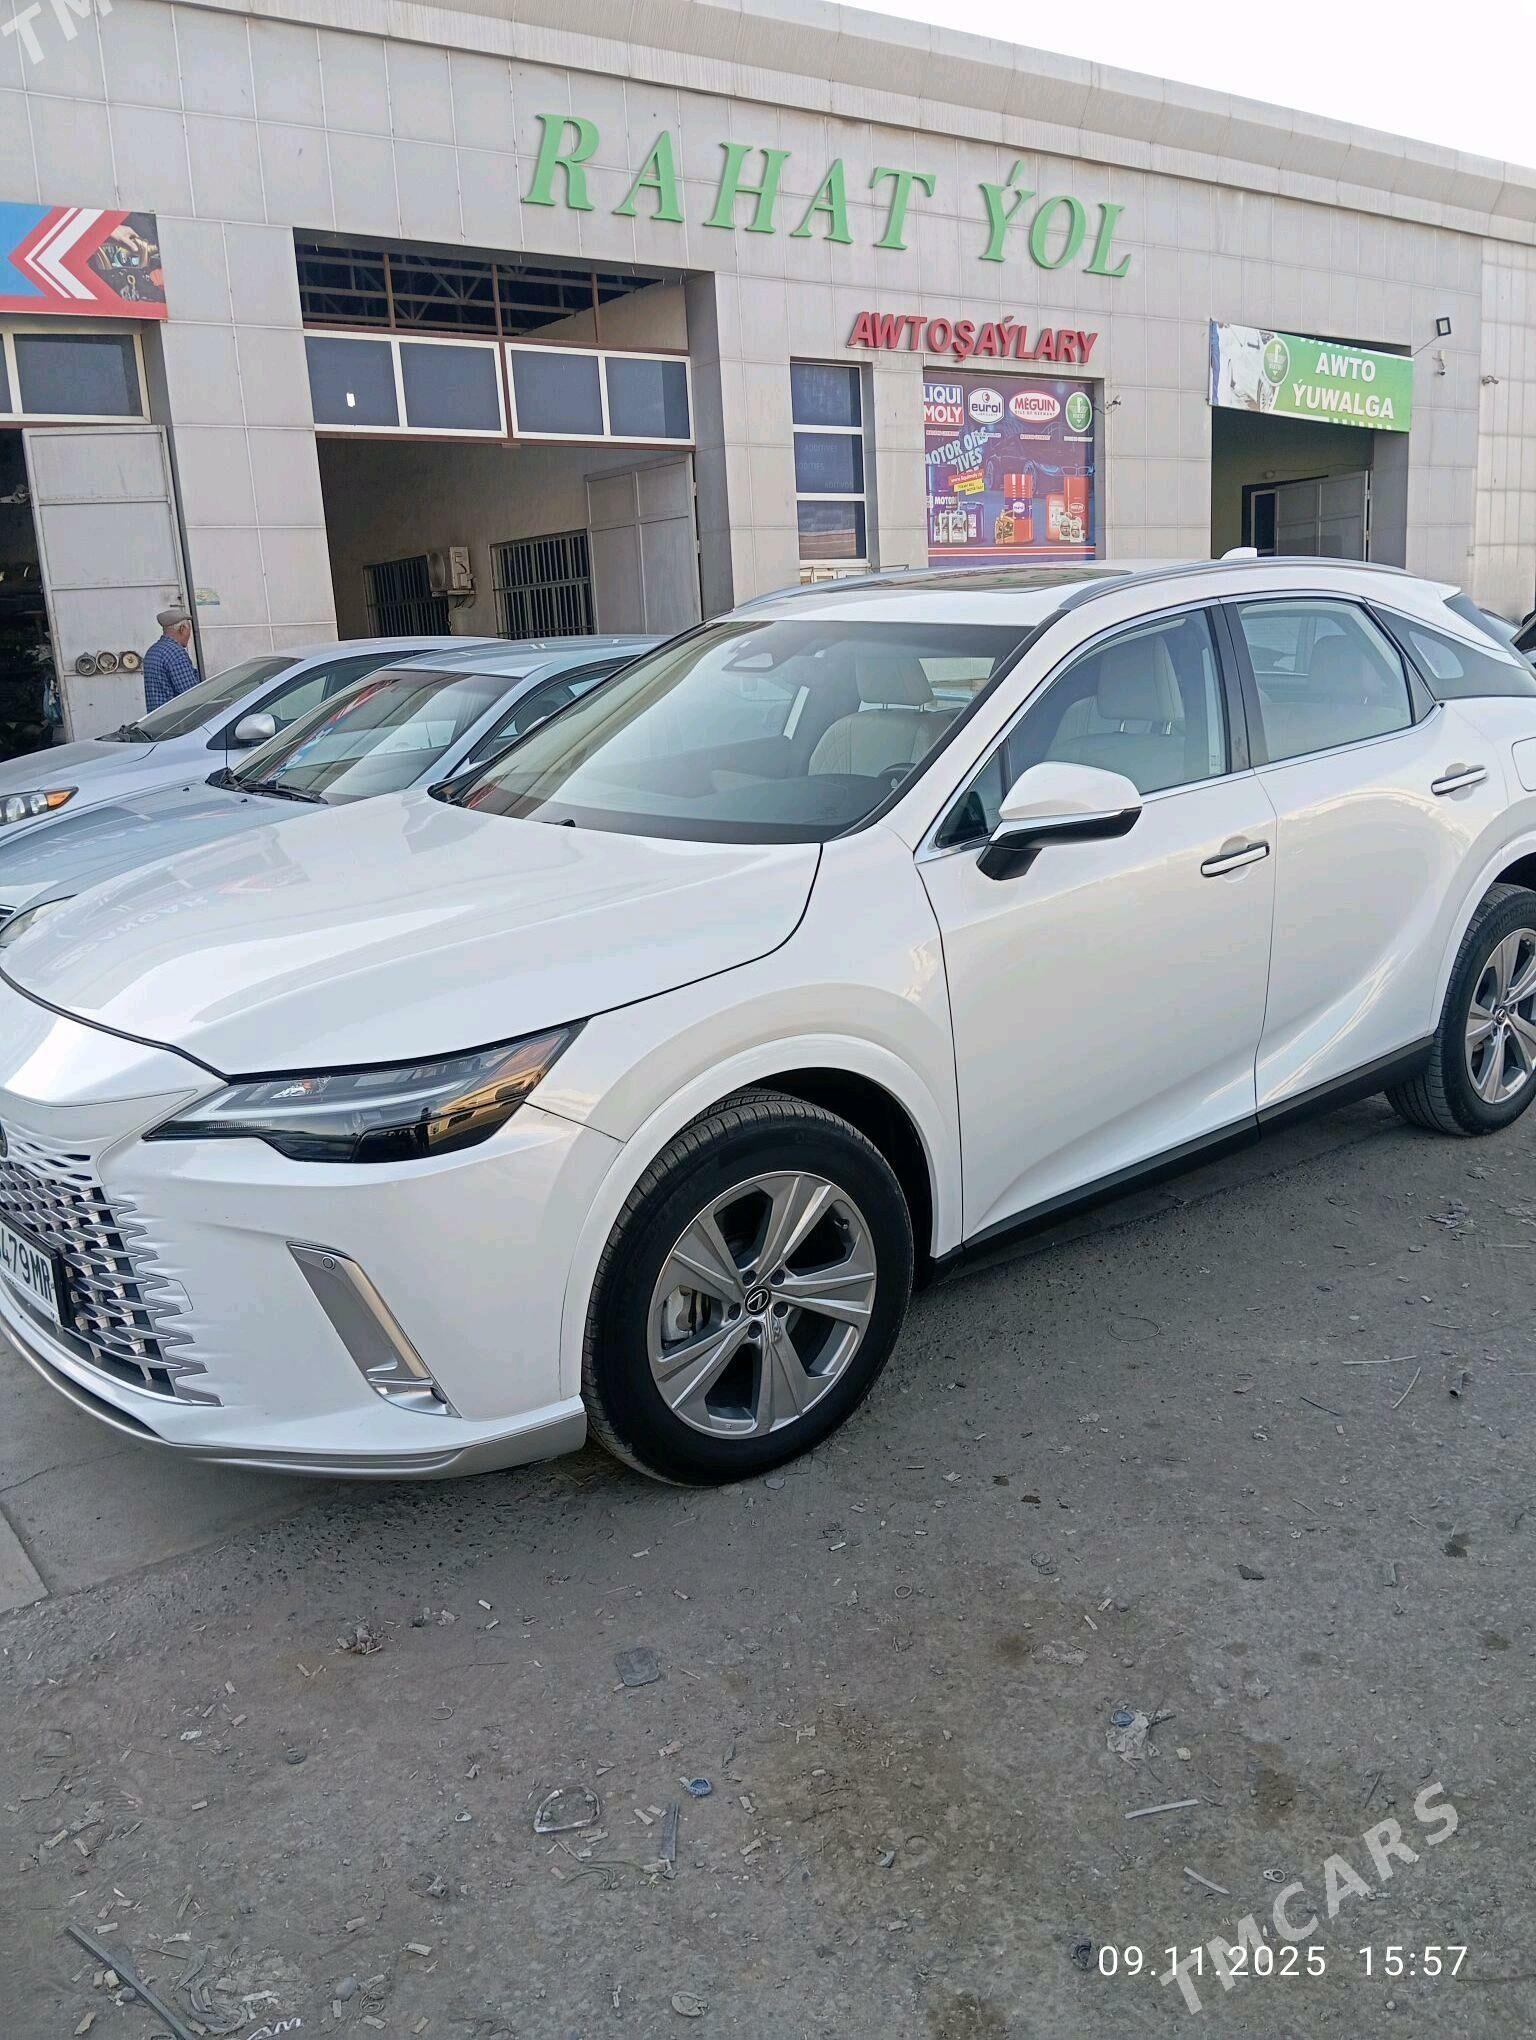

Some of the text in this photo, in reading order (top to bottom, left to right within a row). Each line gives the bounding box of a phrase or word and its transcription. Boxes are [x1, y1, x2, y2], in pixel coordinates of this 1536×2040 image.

[520, 113, 1132, 278] RAHAT ÝOL
[847, 311, 1099, 364] AWTOŞAÝLARY
[1315, 352, 1376, 382] AWTO
[923, 386, 961, 404] LIQUI
[971, 402, 1001, 414] eurol
[1014, 396, 1056, 412] MÉGUIN
[1292, 379, 1395, 420] ÝUWALGA
[923, 405, 962, 423] MOLY
[0, 1227, 53, 1304] 479MR
